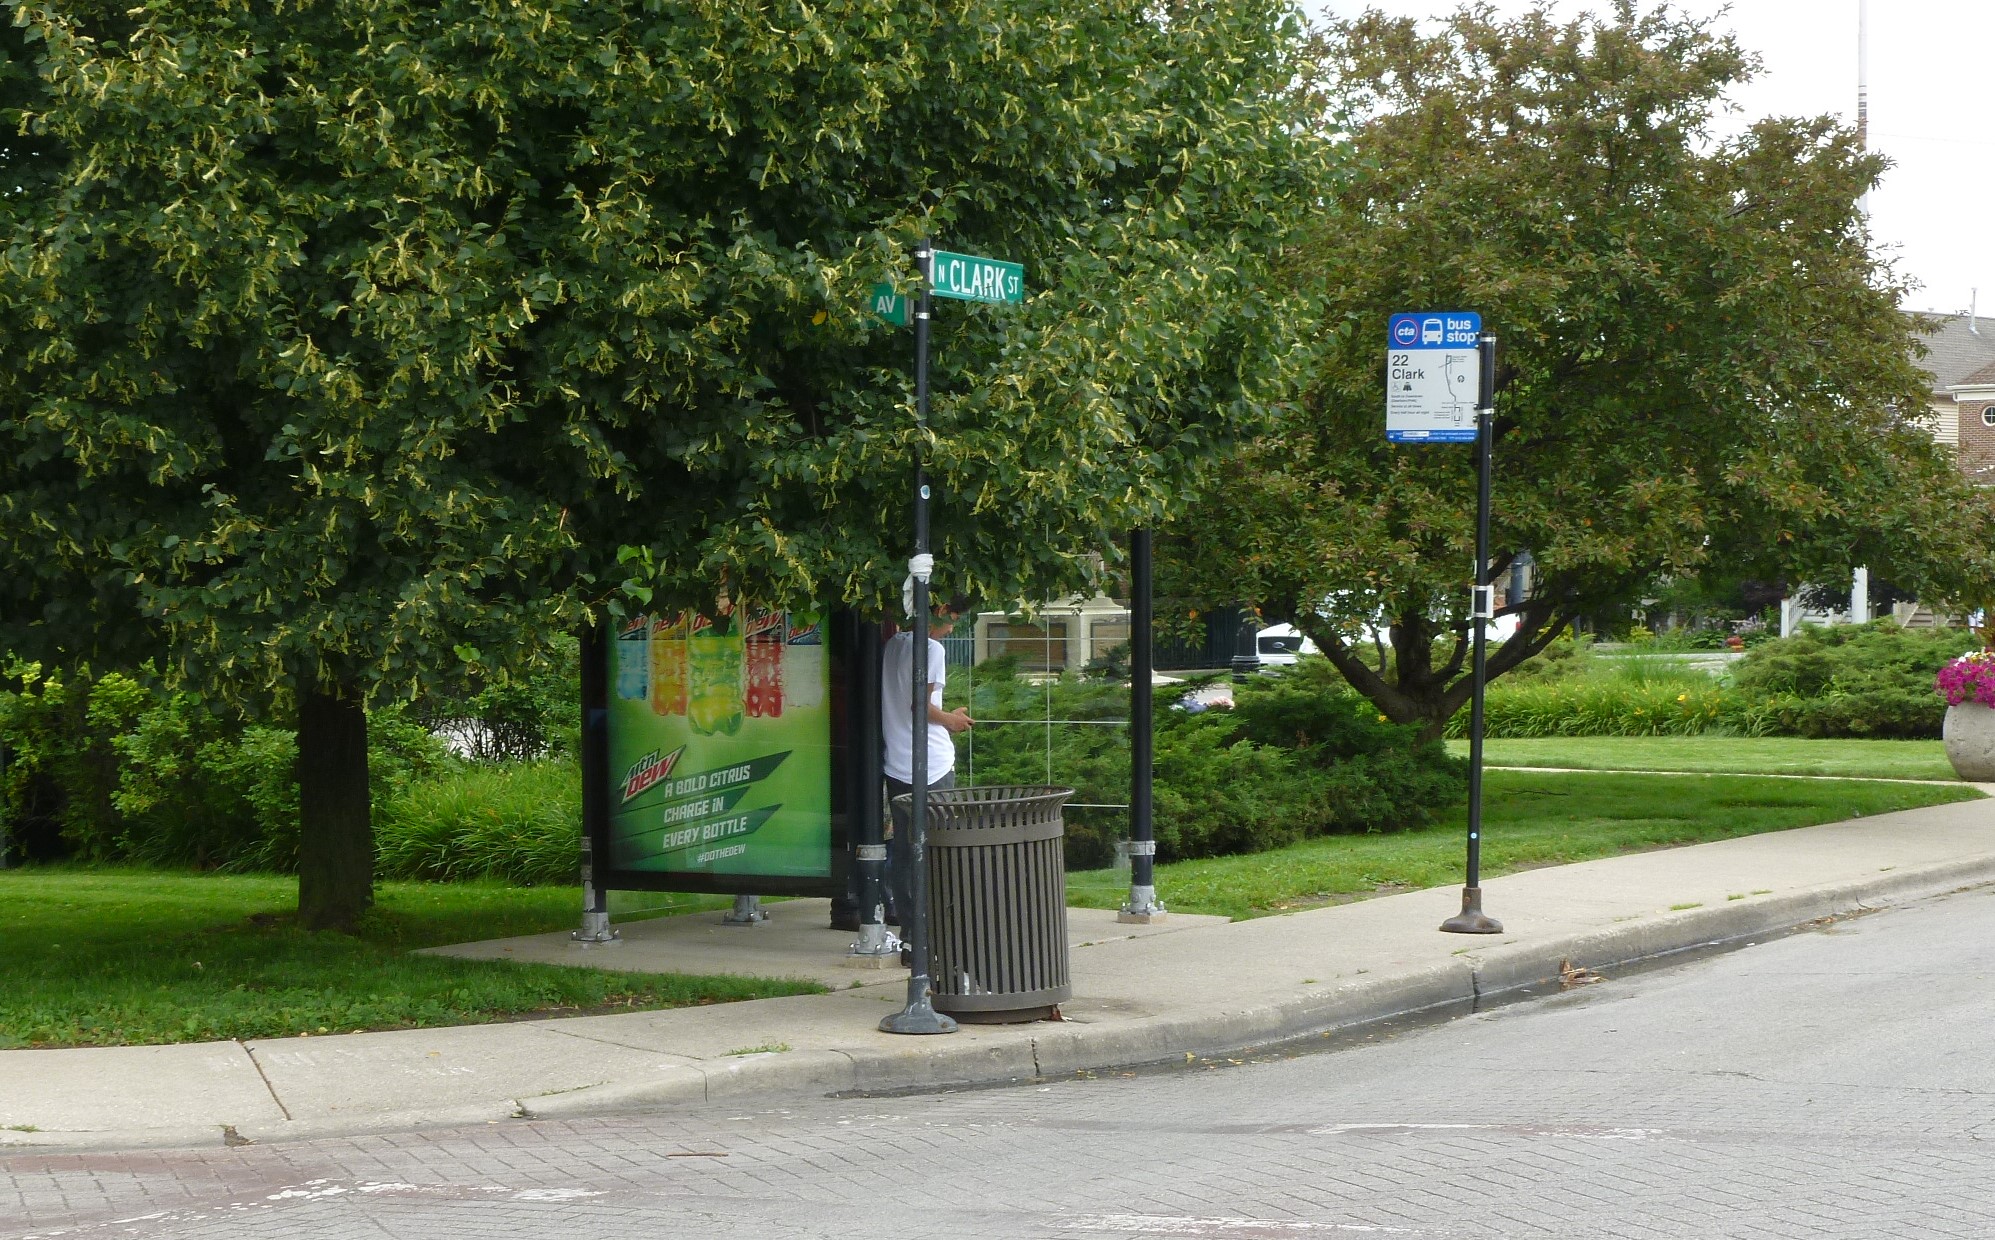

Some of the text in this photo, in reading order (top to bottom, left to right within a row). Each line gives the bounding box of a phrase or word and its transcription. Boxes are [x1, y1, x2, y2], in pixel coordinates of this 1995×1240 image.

[938, 259, 1019, 299] N CLARK ST
[876, 295, 896, 314] AV
[1398, 327, 1415, 336] cta
[1447, 318, 1471, 330] bus
[1447, 331, 1476, 345] stop
[1392, 355, 1409, 367] 22
[1392, 369, 1425, 380] Clark
[664, 783, 674, 798] A
[676, 775, 707, 794] BOLD
[664, 800, 709, 823] CHARGE
[662, 816, 748, 849] EVERY BOTTLE
[697, 843, 746, 864] #DOTHEDEW
